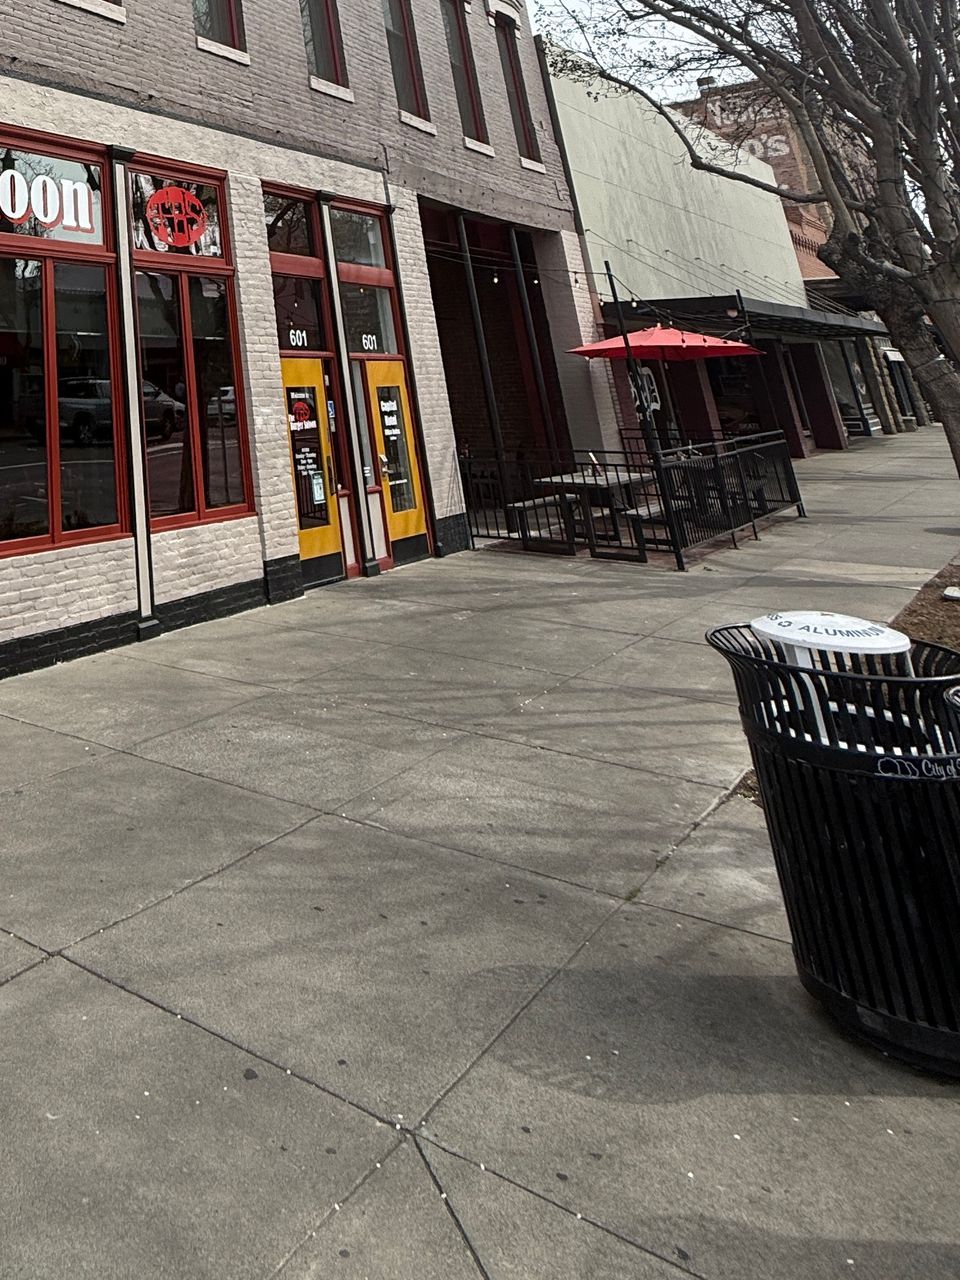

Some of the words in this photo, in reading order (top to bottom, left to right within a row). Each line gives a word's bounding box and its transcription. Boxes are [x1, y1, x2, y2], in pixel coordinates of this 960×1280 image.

[289, 329, 307, 347] 601
[362, 333, 377, 350] 601
[798, 624, 884, 639] ALUMINUM
[921, 759, 946, 780] City
[946, 759, 958, 778] of
